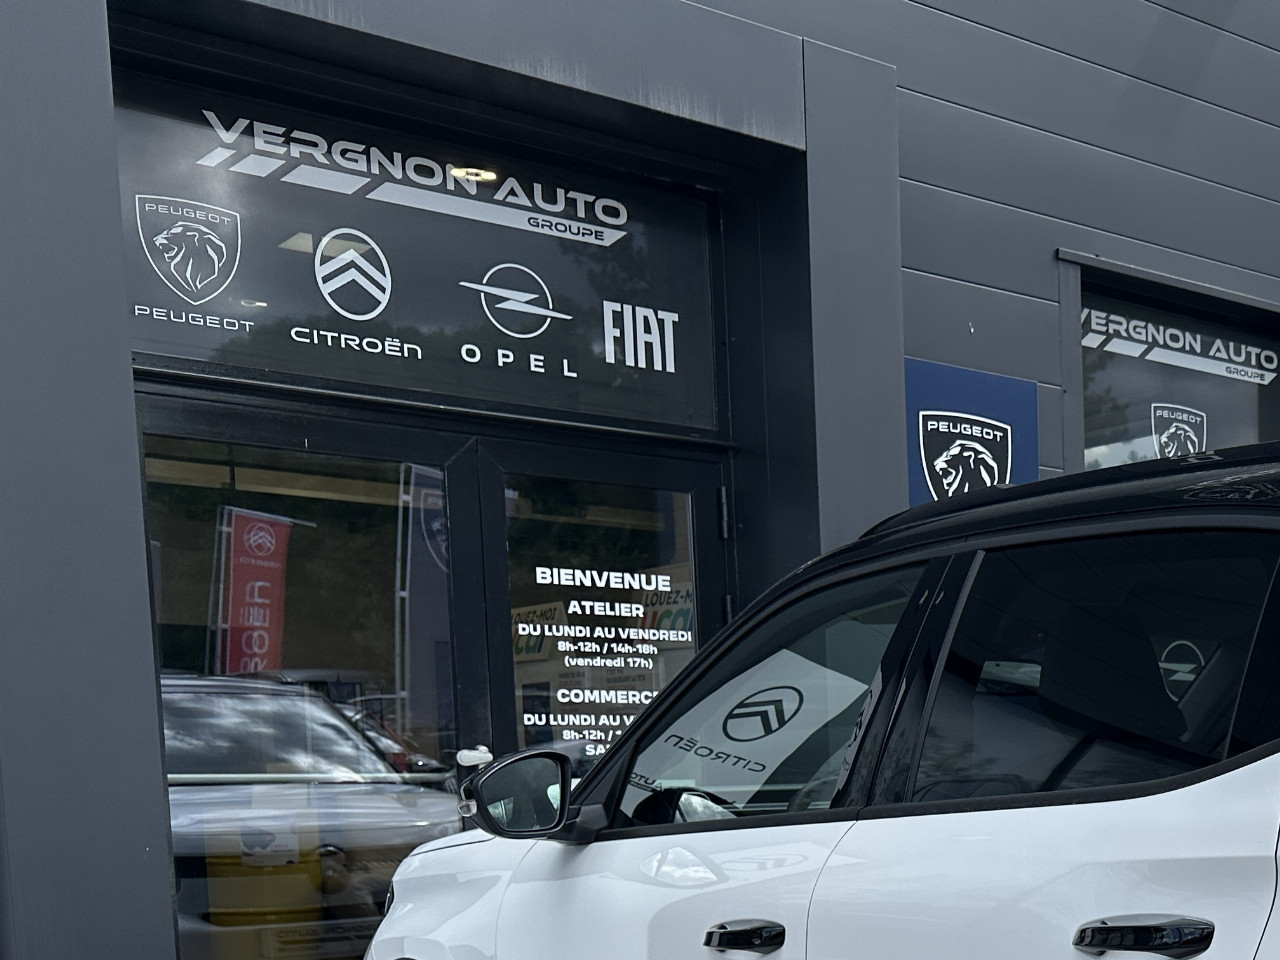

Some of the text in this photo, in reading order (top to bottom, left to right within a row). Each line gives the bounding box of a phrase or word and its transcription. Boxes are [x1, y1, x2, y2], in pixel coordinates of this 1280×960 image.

[202, 110, 628, 226] VERGNON AUTO
[144, 203, 231, 226] PEUGEOT
[527, 215, 605, 242] GROUPE
[134, 305, 254, 333] PEUGEOT
[602, 300, 679, 374] FIAT
[461, 344, 578, 378] OPEL
[1208, 339, 1278, 370] AUTO
[1225, 365, 1266, 381] GROUPE
[1155, 409, 1202, 425] PEUGEOT
[927, 420, 1003, 442] PEUGEOT
[535, 566, 671, 591] BIENVENUE
[567, 600, 644, 617] ATELIER
[518, 623, 692, 642] DU LUNDI AU VENDREDI
[557, 640, 658, 655] 8h-12h / 14h-18h
[564, 655, 653, 670] (vendredi 17h)
[557, 689, 659, 705] COMMERC
[523, 713, 546, 725] DU
[549, 714, 595, 726] LUNDI
[598, 714, 620, 726] AU
[562, 730, 605, 740] 8h-12h
